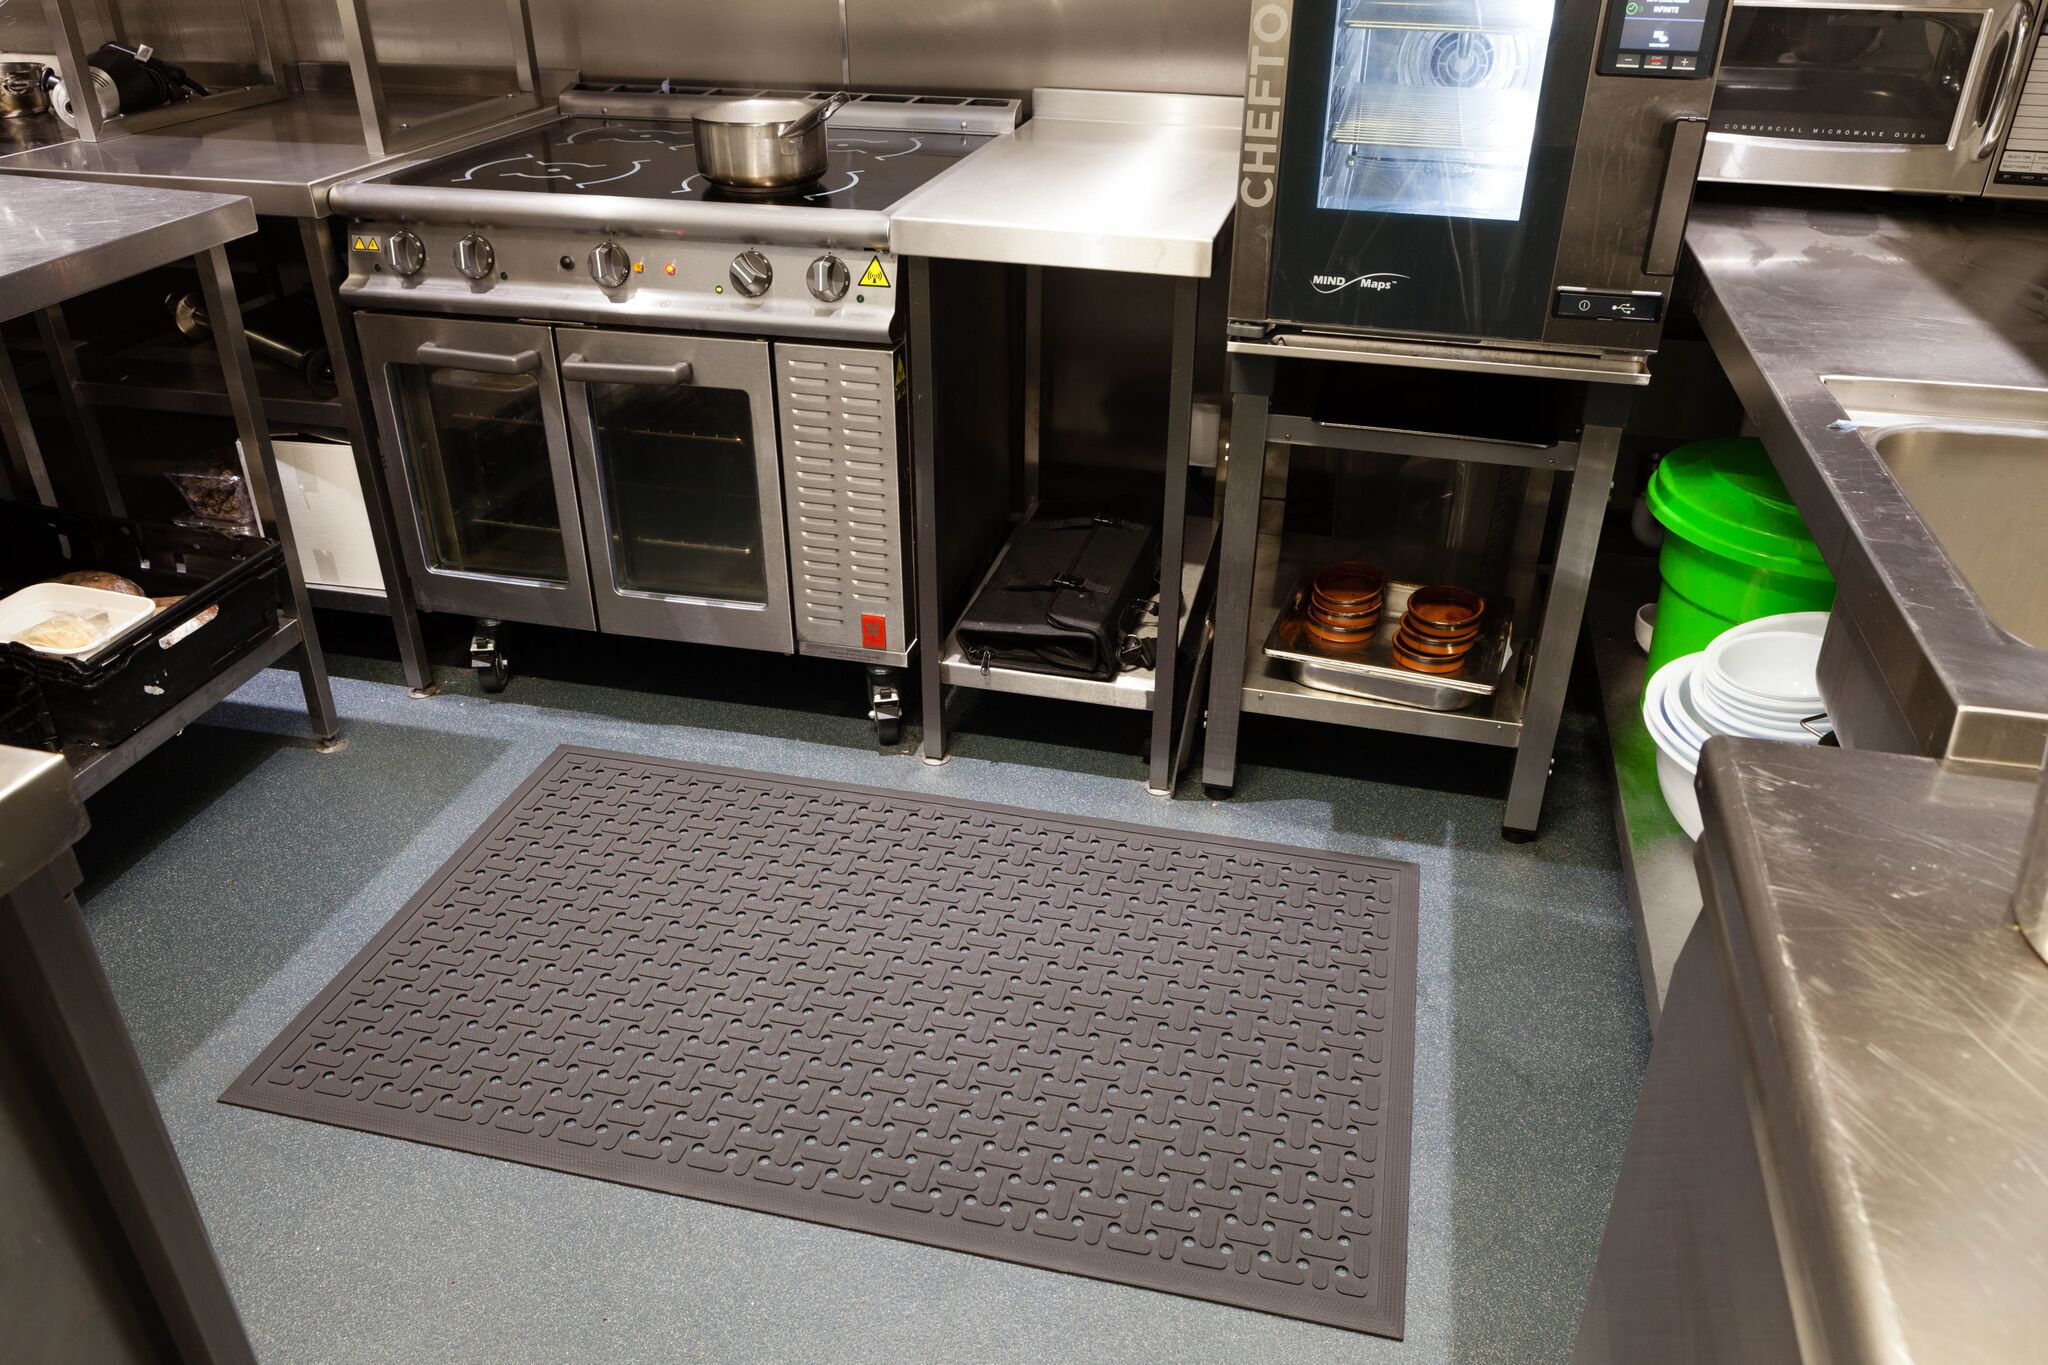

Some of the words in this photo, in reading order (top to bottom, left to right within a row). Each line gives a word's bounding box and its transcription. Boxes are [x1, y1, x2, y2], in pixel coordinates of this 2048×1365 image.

[1653, 6, 1680, 14] INFINITE
[1724, 124, 1803, 133] COMMERCIAL
[1812, 128, 1885, 137] MICROWAVE
[1894, 131, 1926, 140] OVEN
[1312, 275, 1346, 286] MIND
